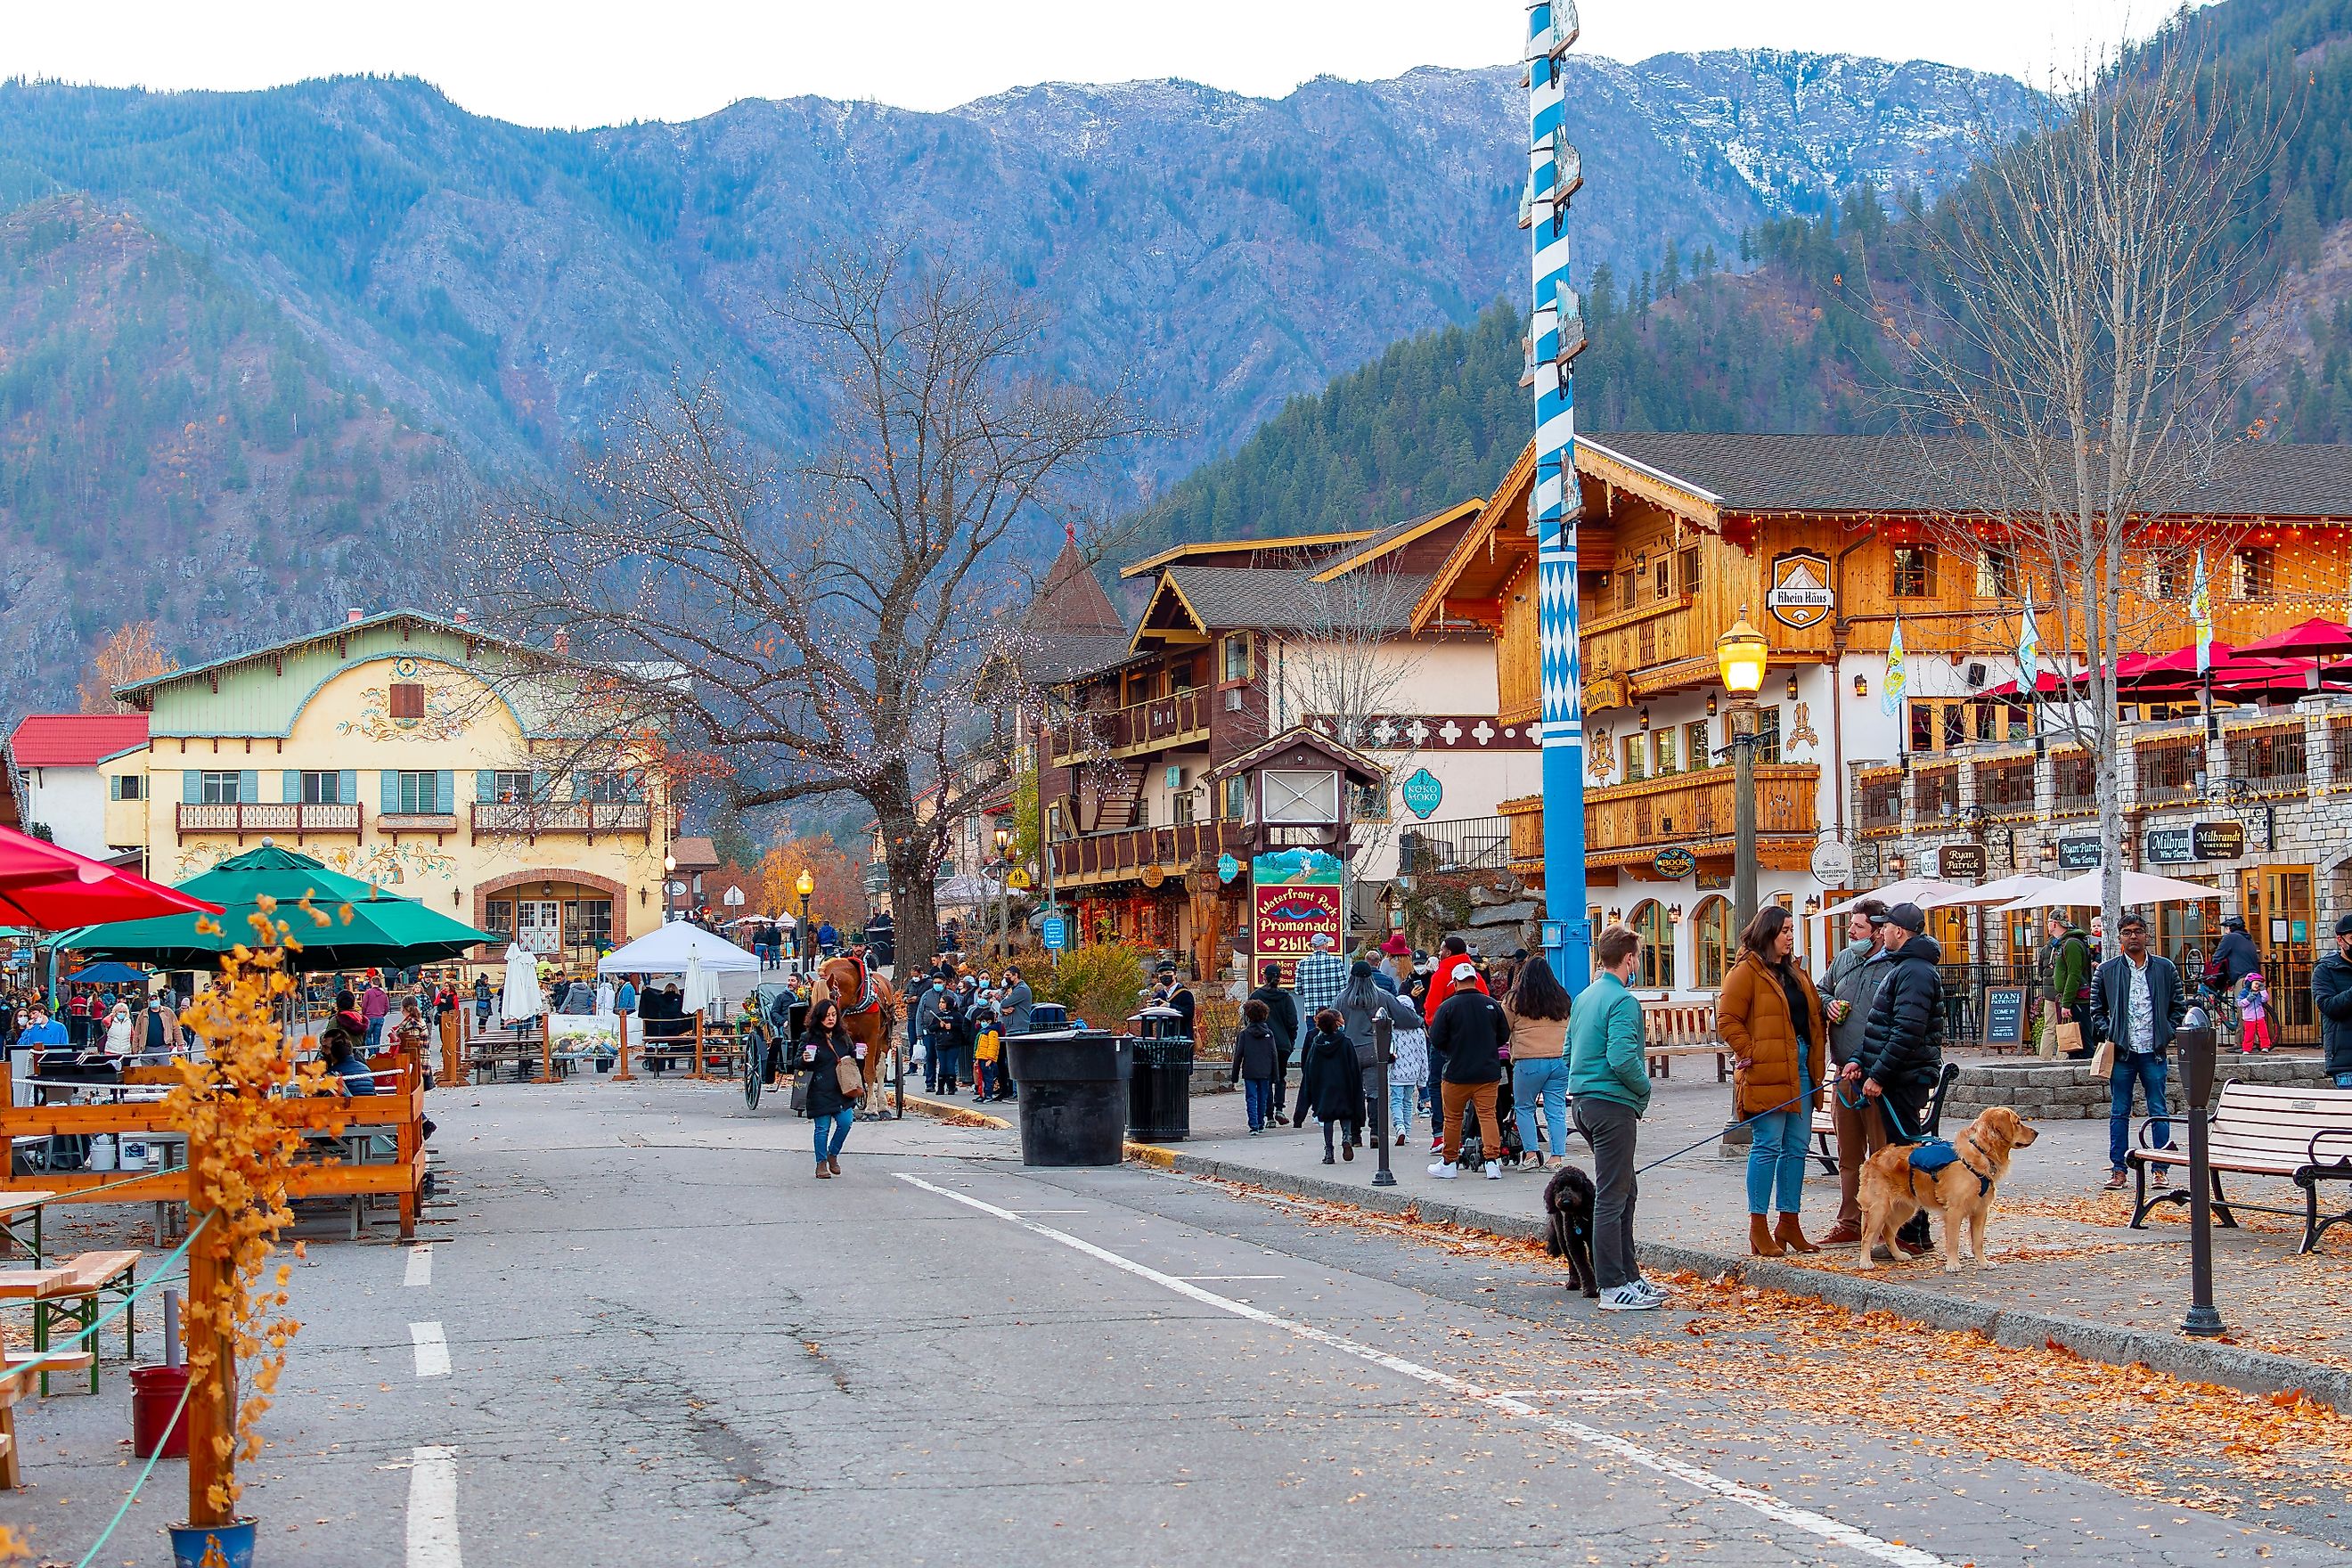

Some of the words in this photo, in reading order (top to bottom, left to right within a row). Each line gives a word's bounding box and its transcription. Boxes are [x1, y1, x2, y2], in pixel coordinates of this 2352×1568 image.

[1778, 592, 1802, 603] Rhein
[1154, 705, 1173, 727] Hoel
[1408, 785, 1437, 793] KOKO
[2152, 832, 2189, 850] Milbran
[2196, 830, 2241, 842] Milbrandt
[1948, 850, 1974, 862] Ryan
[2062, 843, 2079, 858] Ryan
[2079, 842, 2102, 853] Patric
[2160, 851, 2171, 859] Wine
[1662, 859, 1691, 867] BOOK
[1946, 859, 1979, 870] Patrick
[2070, 856, 2080, 864] Wine
[1259, 887, 1315, 915] Waterfront
[1318, 894, 1338, 917] Park
[1259, 918, 1337, 932] Promenade
[1279, 936, 1314, 951] 2blk
